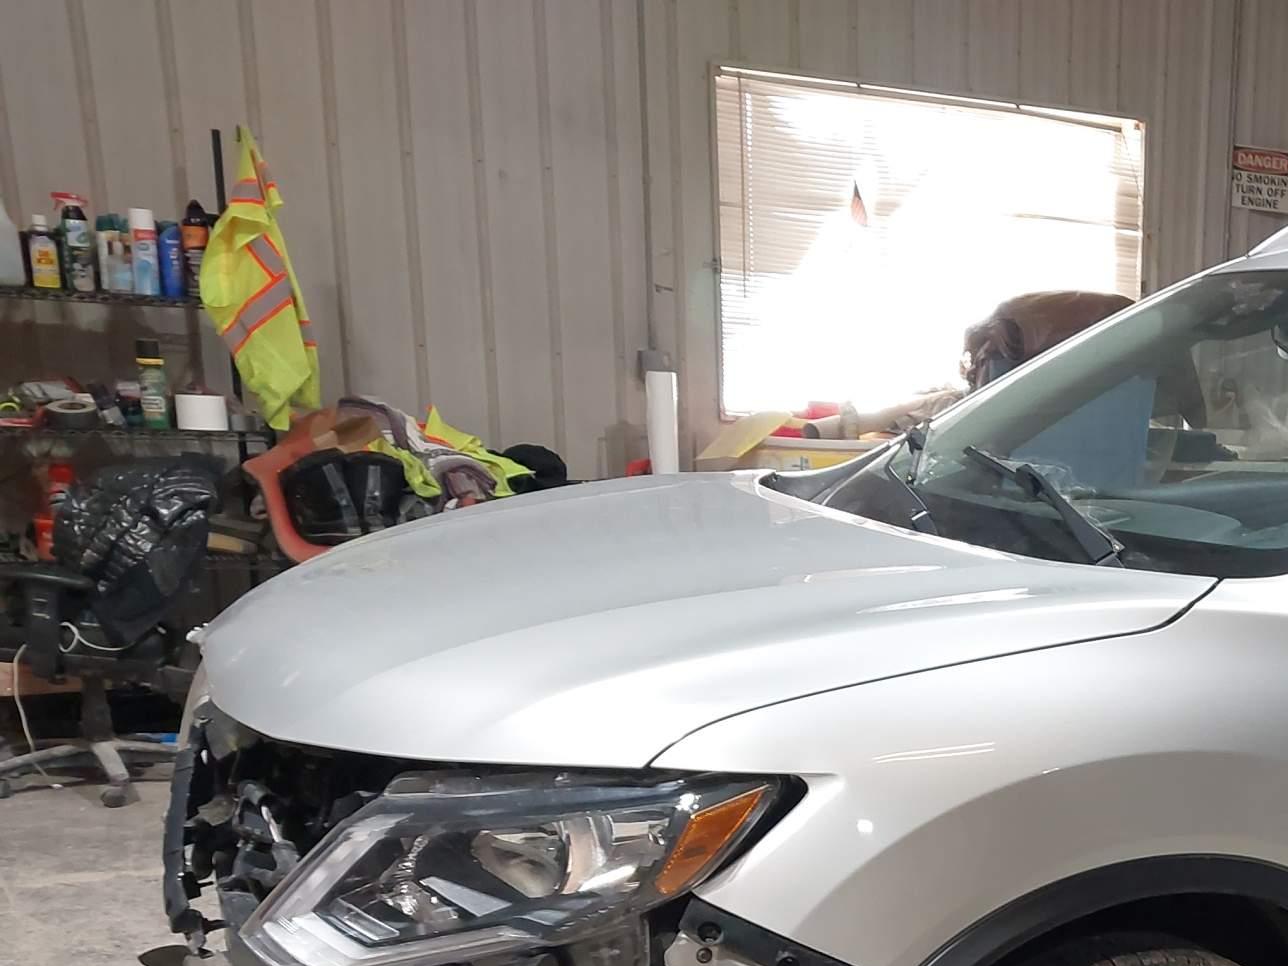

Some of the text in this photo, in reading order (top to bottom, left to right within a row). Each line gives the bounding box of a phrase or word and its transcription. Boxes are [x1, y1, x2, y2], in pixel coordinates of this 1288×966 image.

[1239, 153, 1288, 170] DANGER
[1235, 184, 1287, 199] TURN OFF
[1241, 196, 1279, 209] ENGINE
